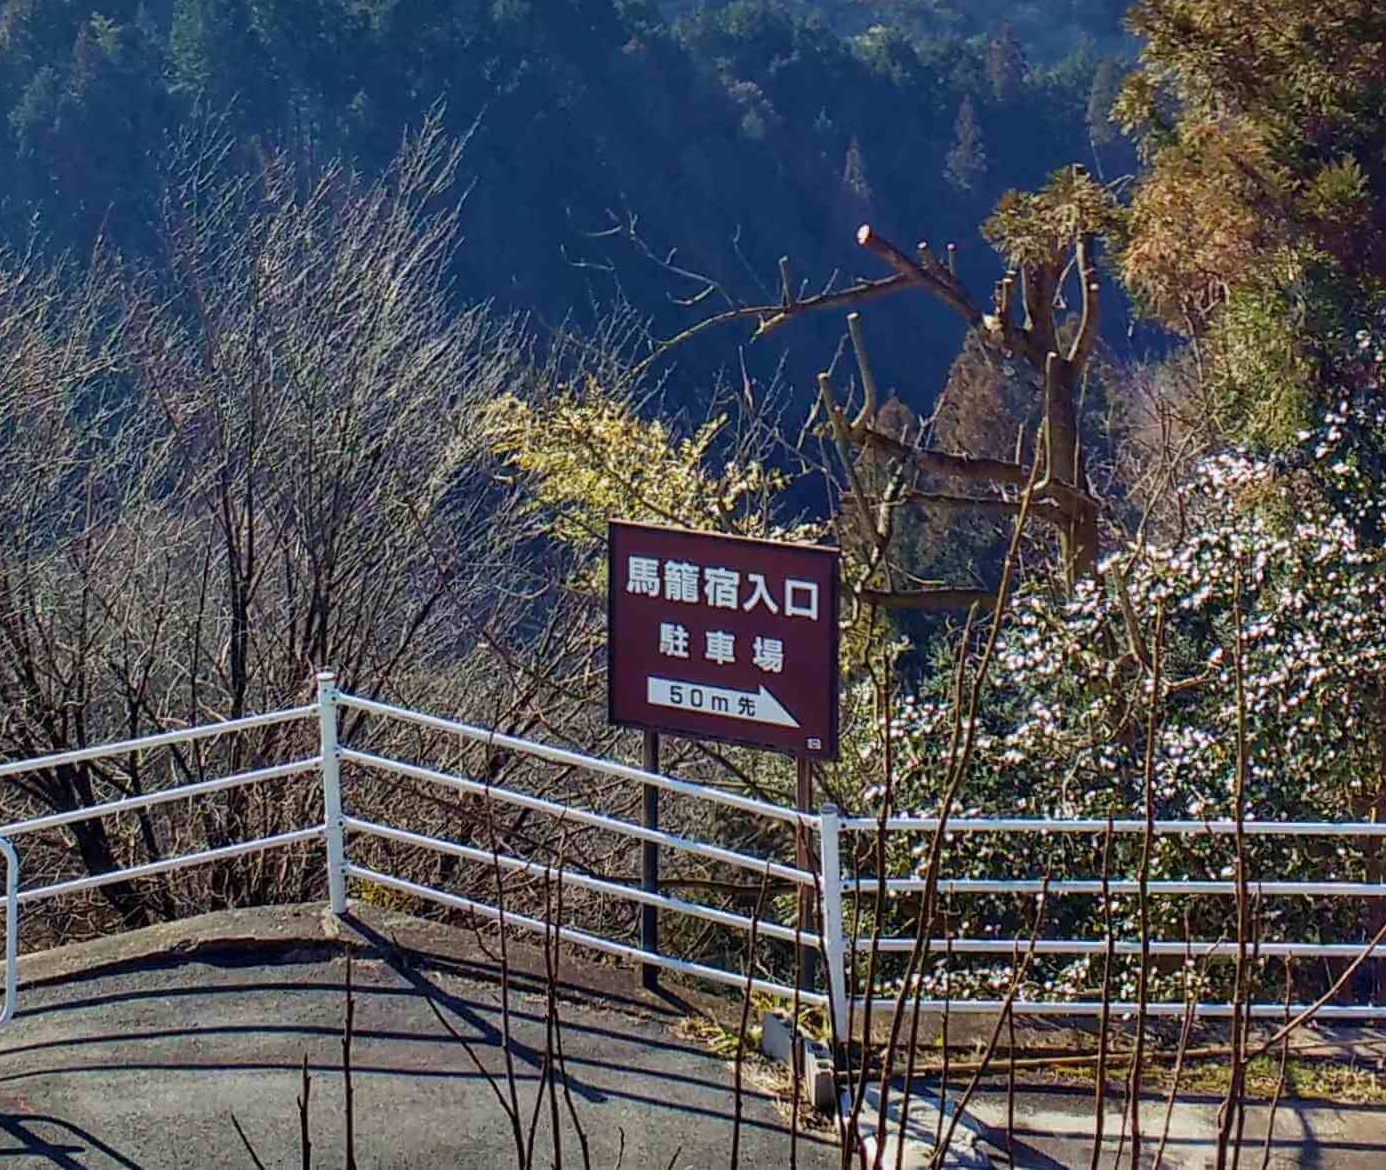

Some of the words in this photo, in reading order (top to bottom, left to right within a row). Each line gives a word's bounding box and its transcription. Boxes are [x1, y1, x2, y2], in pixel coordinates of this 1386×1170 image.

[626, 556, 818, 620] 馬籠宿入口
[659, 623, 784, 672] 駐車場
[669, 685, 756, 717] 50m先
